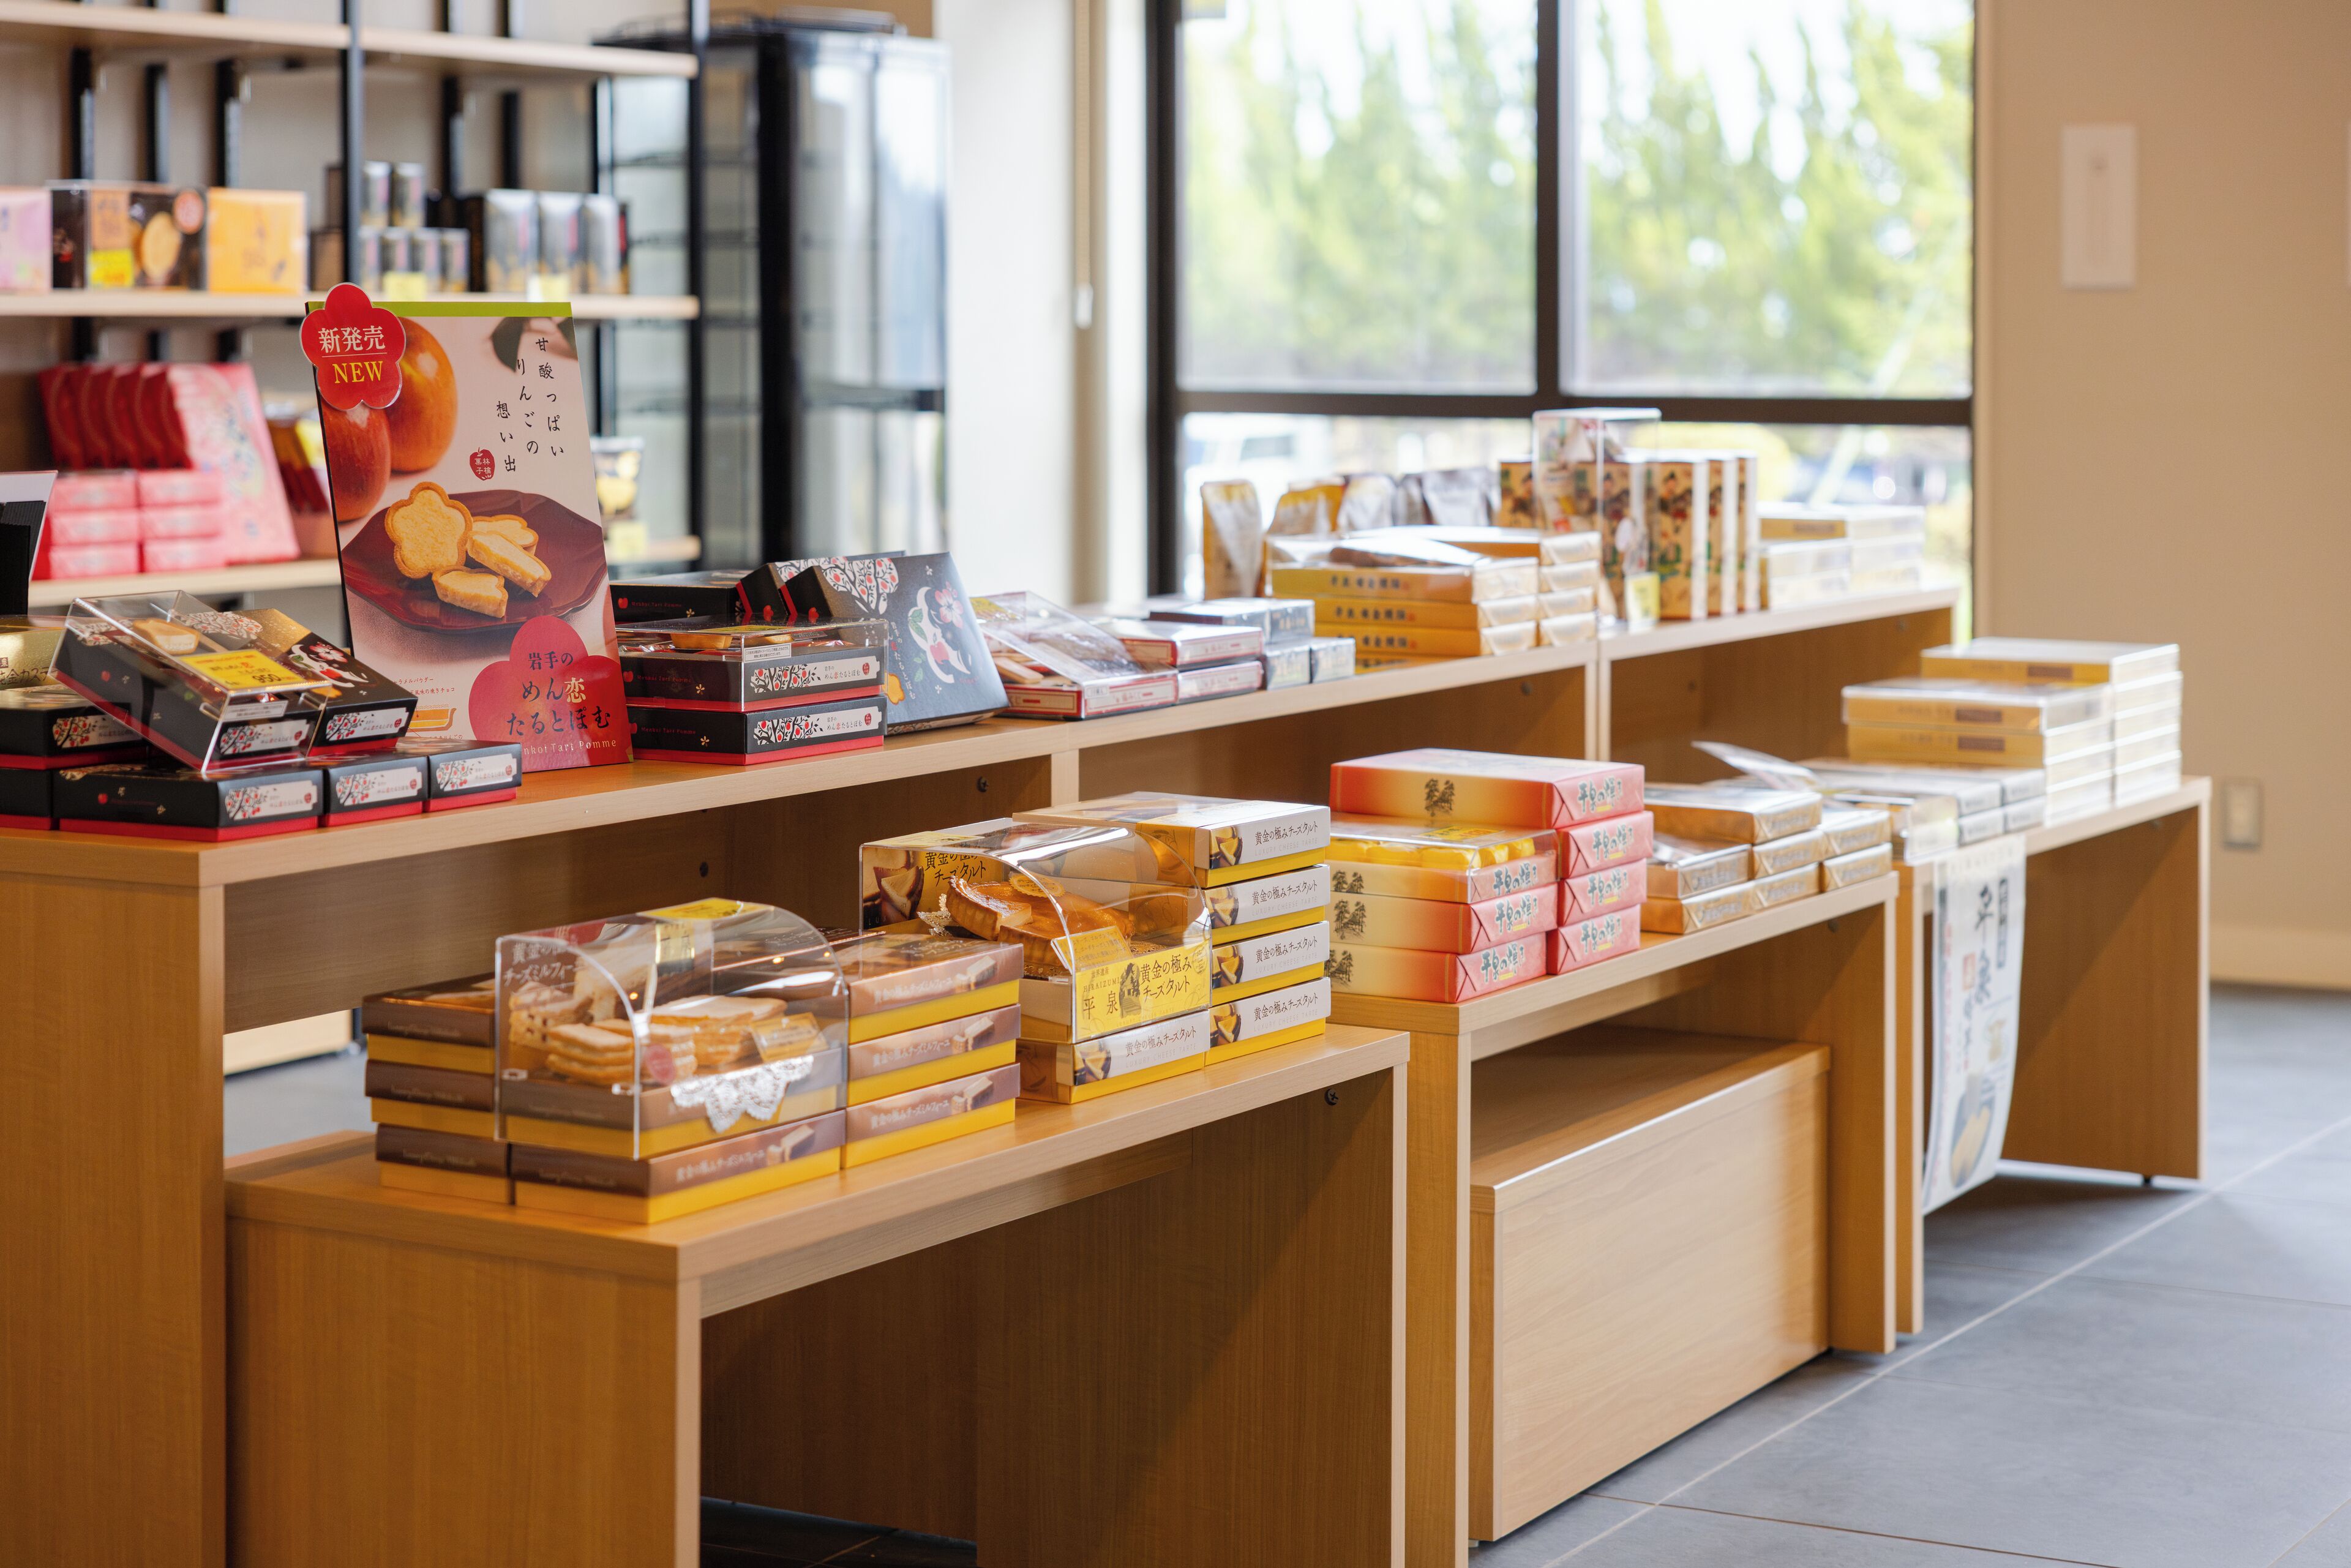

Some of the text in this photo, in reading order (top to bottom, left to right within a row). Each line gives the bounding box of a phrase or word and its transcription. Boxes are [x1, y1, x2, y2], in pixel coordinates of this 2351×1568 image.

[318, 325, 386, 354] 新発売
[332, 361, 384, 384] NEW
[517, 358, 539, 454] りんごの
[535, 337, 564, 457] 甘酸っぱい
[497, 400, 517, 473] 想い出
[528, 651, 574, 670] 岩手の
[252, 673, 282, 684] 950
[824, 670, 861, 680] めん恋たるとぽむ
[522, 677, 587, 703] めん恋
[506, 705, 611, 736] たるとぽむ
[827, 720, 863, 730] めん恋たるとぽむ
[523, 739, 617, 756] nkoi Tart Pomme
[1255, 821, 1318, 846] 黄金の極みチーズタルト
[1279, 842, 1299, 852] CHEESE
[924, 852, 978, 871] 黄金の
[934, 860, 986, 887] チーズタルト
[1252, 879, 1318, 906] 黄金の極みチーズタルト
[1278, 901, 1298, 910] CHEESE
[1496, 894, 1538, 934] 平泉の輝き
[1256, 936, 1318, 964] 黄金の極みチーズタルト
[1480, 943, 1524, 983] 平泉の輝き
[1141, 954, 1192, 985] 黄金の極み
[1083, 977, 1120, 994] HIRAIZUMI
[1143, 975, 1190, 1003] チーズタルト
[1083, 990, 1119, 1019] 平泉
[1254, 992, 1318, 1021] 黄金の極みチーズタルト
[1278, 1015, 1299, 1026] CHEESE
[1125, 1026, 1196, 1057] 黄金の極みチーズタルト
[1153, 1049, 1176, 1060] CHEESE
